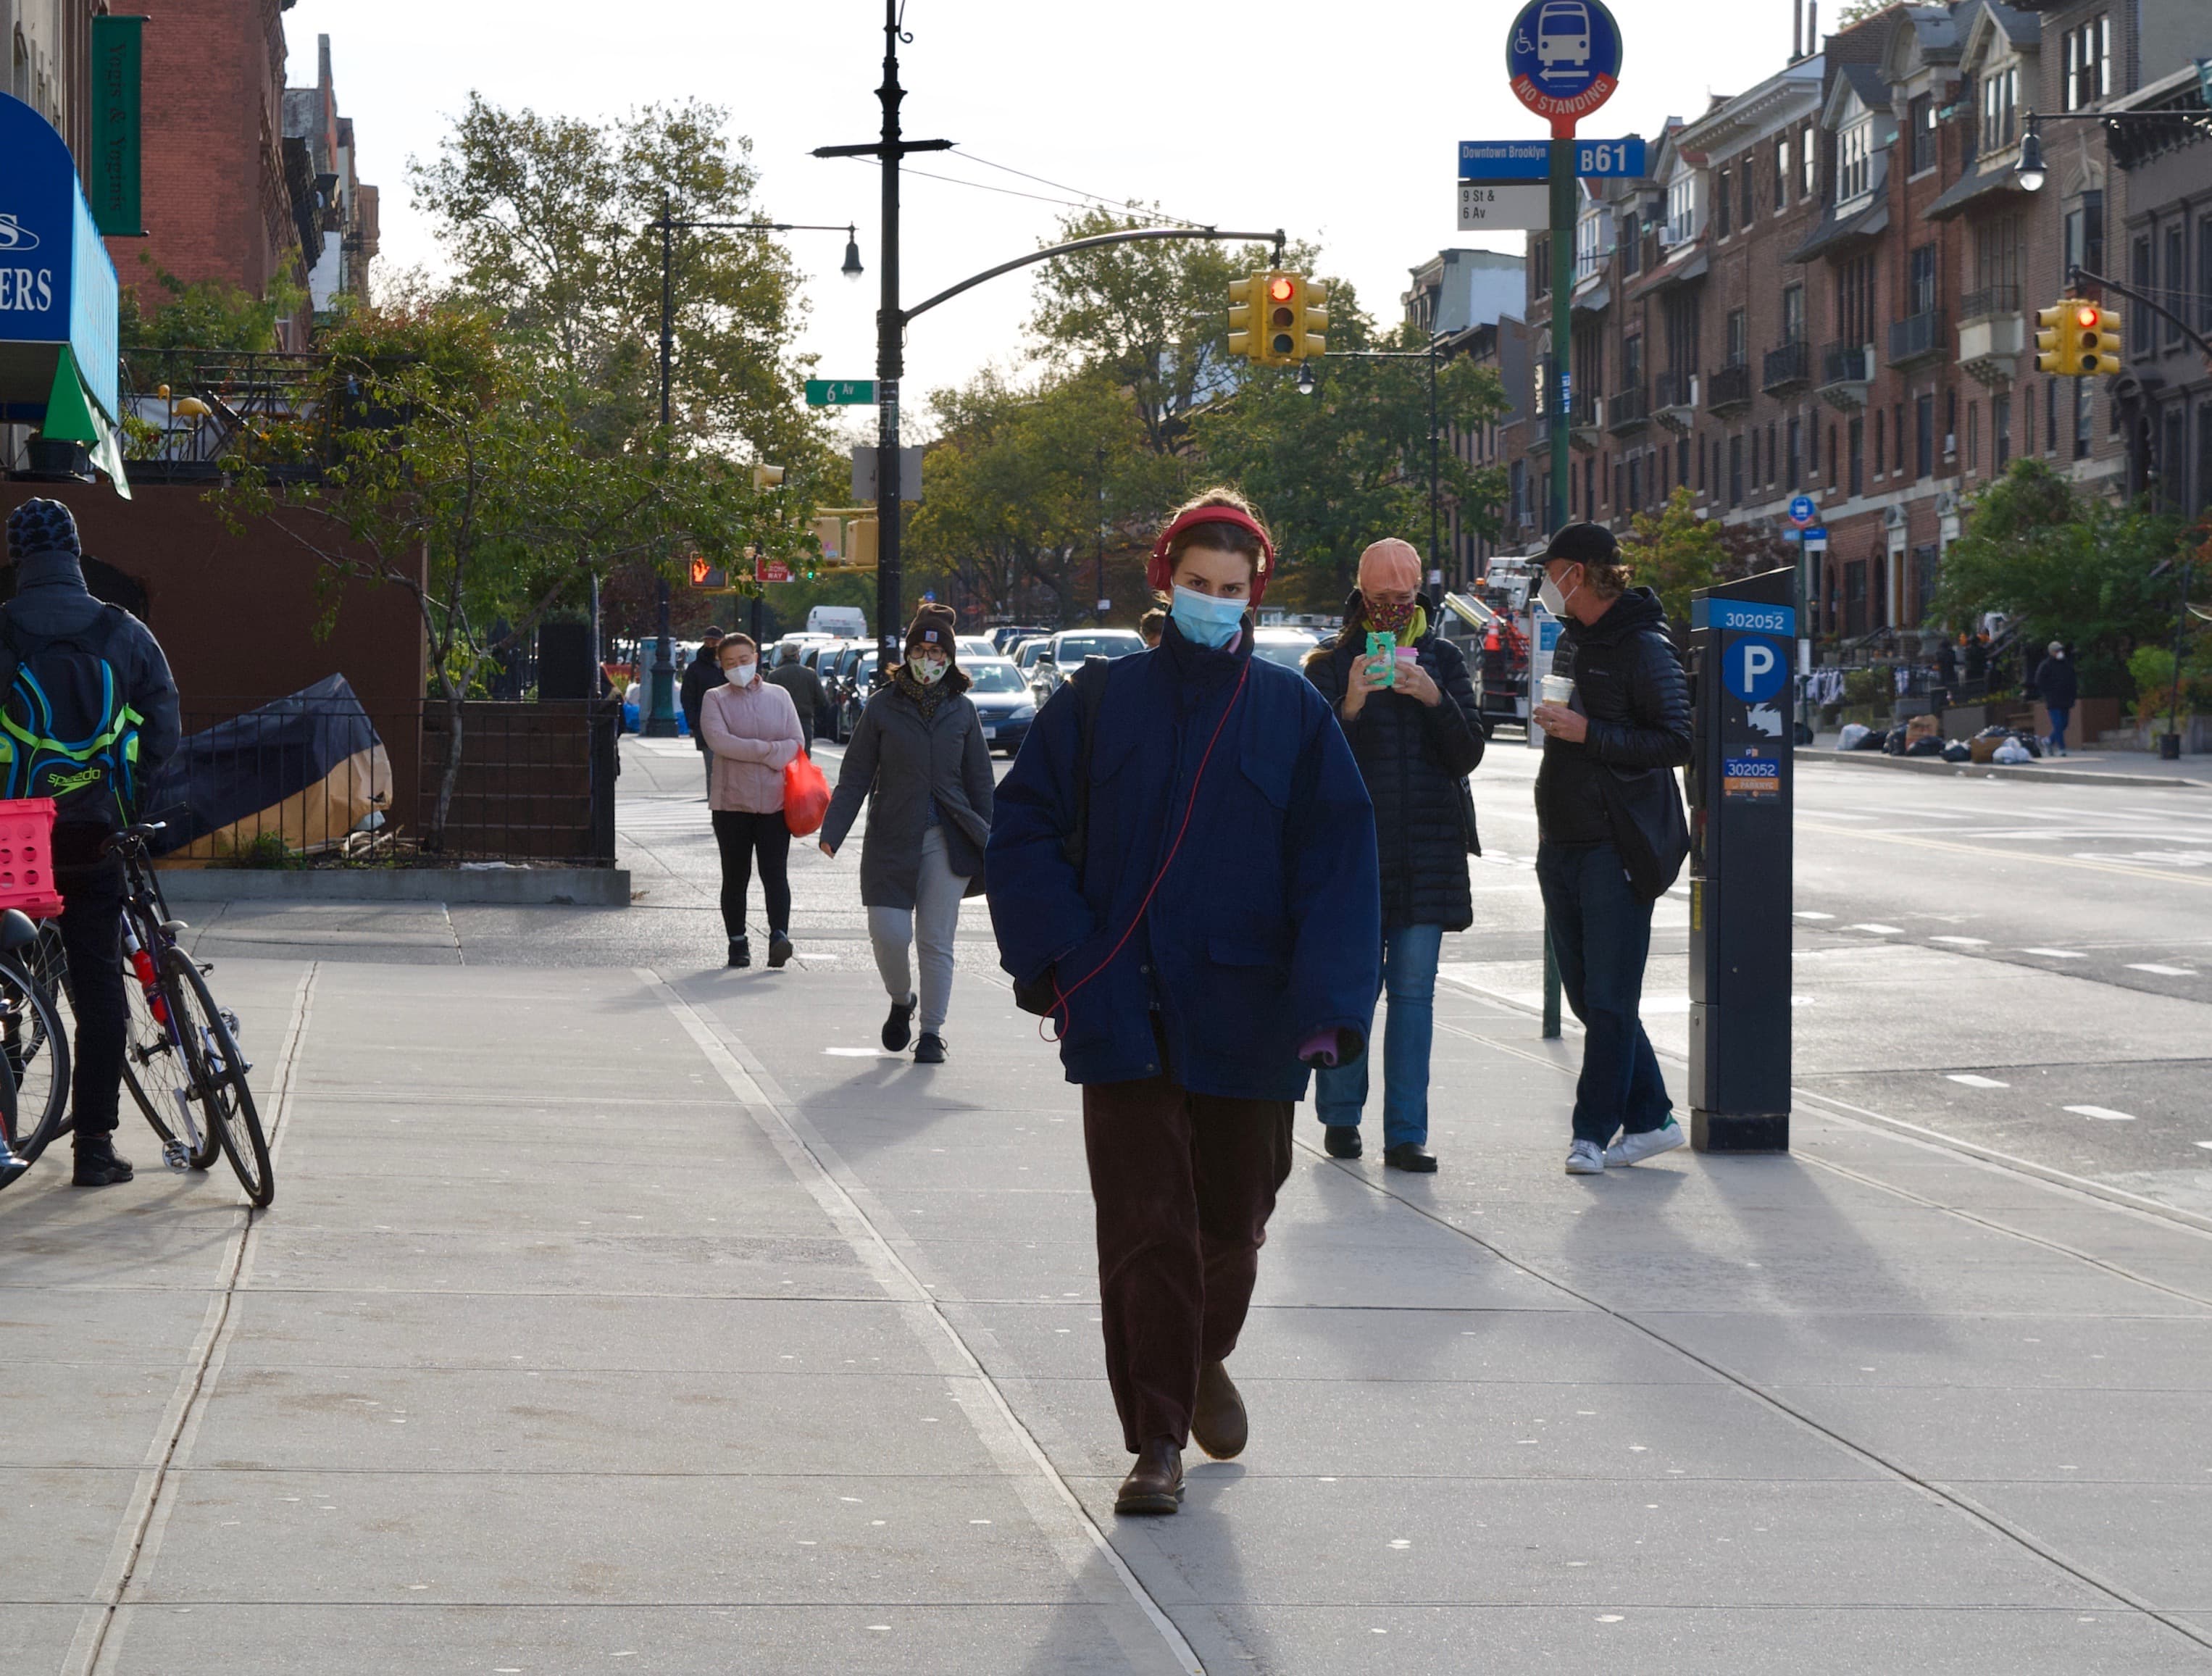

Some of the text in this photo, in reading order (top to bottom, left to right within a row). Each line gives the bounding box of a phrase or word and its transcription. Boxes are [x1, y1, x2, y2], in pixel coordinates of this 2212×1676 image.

[1518, 79, 1608, 114] NO STANDING
[1463, 146, 1546, 160] Downtown Brooklyn
[1581, 144, 1626, 172] B61
[1463, 189, 1495, 202] 9 St &
[1463, 207, 1486, 219] 6 Av
[827, 383, 854, 401] 6 Av
[1726, 612, 1784, 630] 302052
[1744, 645, 1774, 693] P
[1728, 763, 1776, 776] 302052
